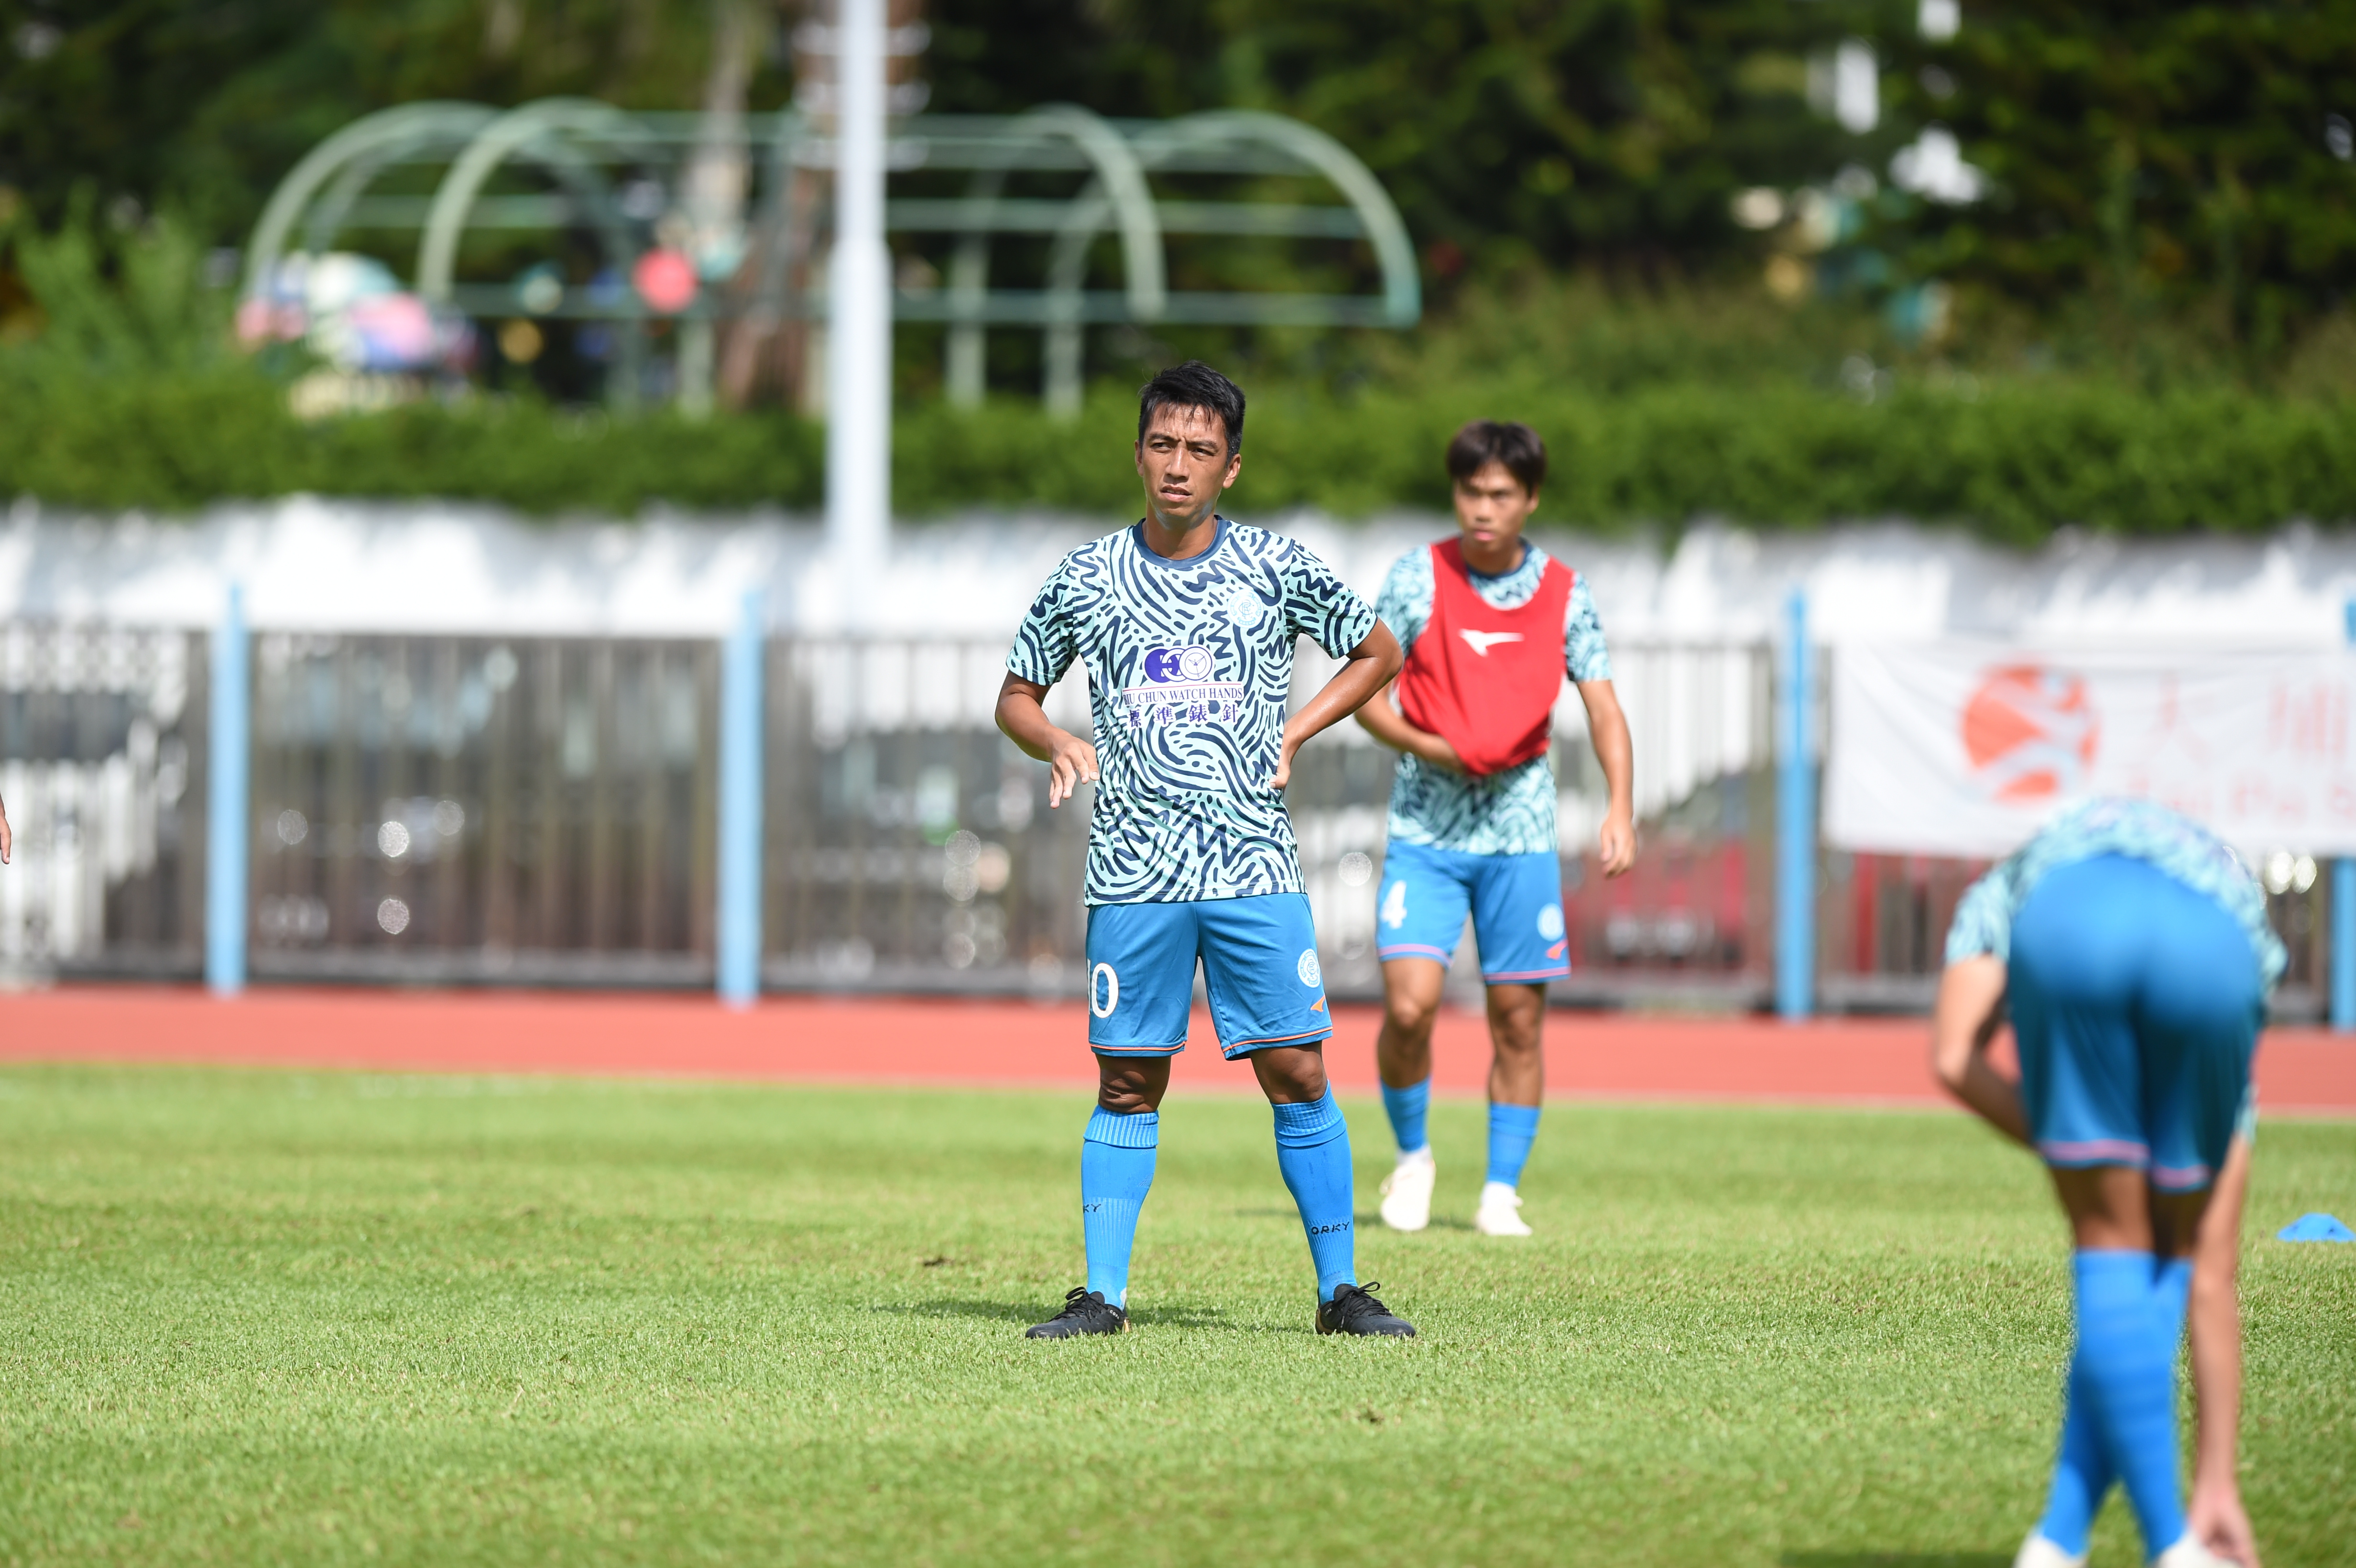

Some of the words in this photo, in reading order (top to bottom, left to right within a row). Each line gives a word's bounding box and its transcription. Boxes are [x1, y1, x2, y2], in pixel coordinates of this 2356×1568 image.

[1123, 694, 1135, 705] BIU
[1138, 691, 1167, 703] CHUN
[1169, 688, 1206, 700] WATCH
[1209, 687, 1243, 699] HANDS
[1380, 880, 1407, 929] 4
[1311, 1221, 1350, 1235] ORKY
